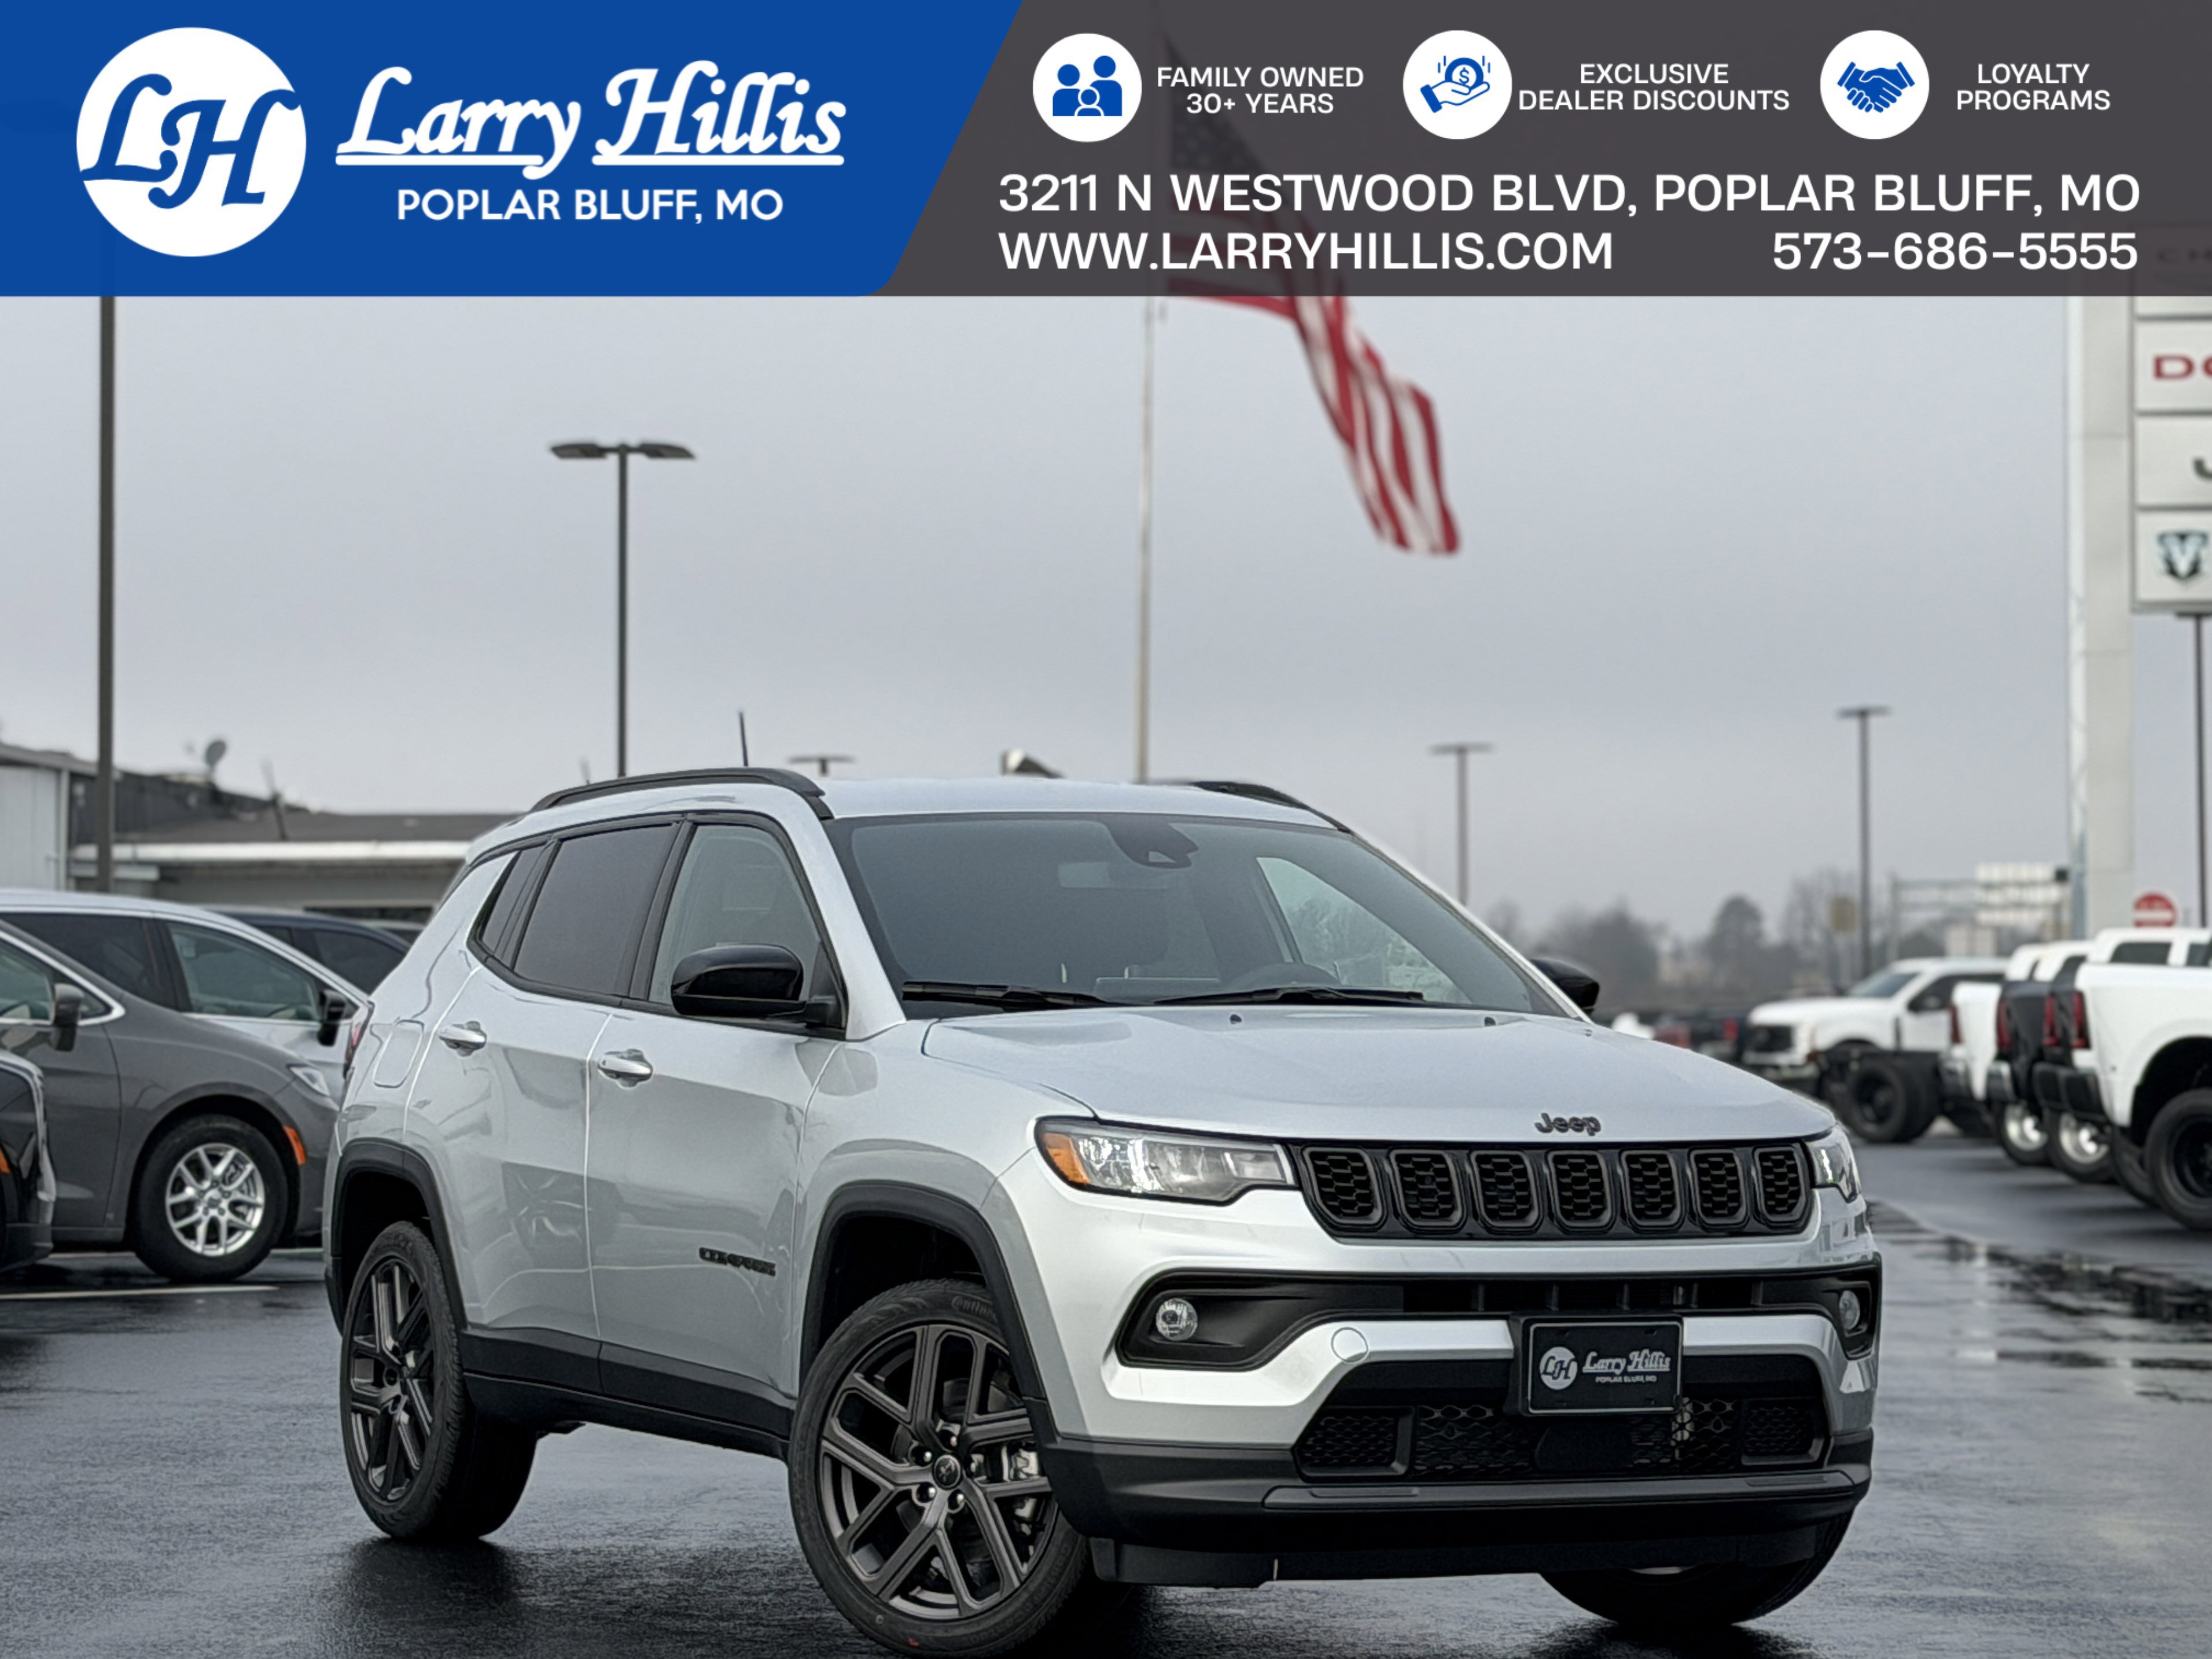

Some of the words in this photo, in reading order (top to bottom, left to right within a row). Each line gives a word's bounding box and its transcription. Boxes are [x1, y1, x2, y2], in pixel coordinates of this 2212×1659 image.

[2154, 354, 2212, 381] D
[1534, 1112, 1602, 1136] Jeep
[1582, 1351, 1626, 1375] Larry
[1627, 1348, 1672, 1372] Hillis
